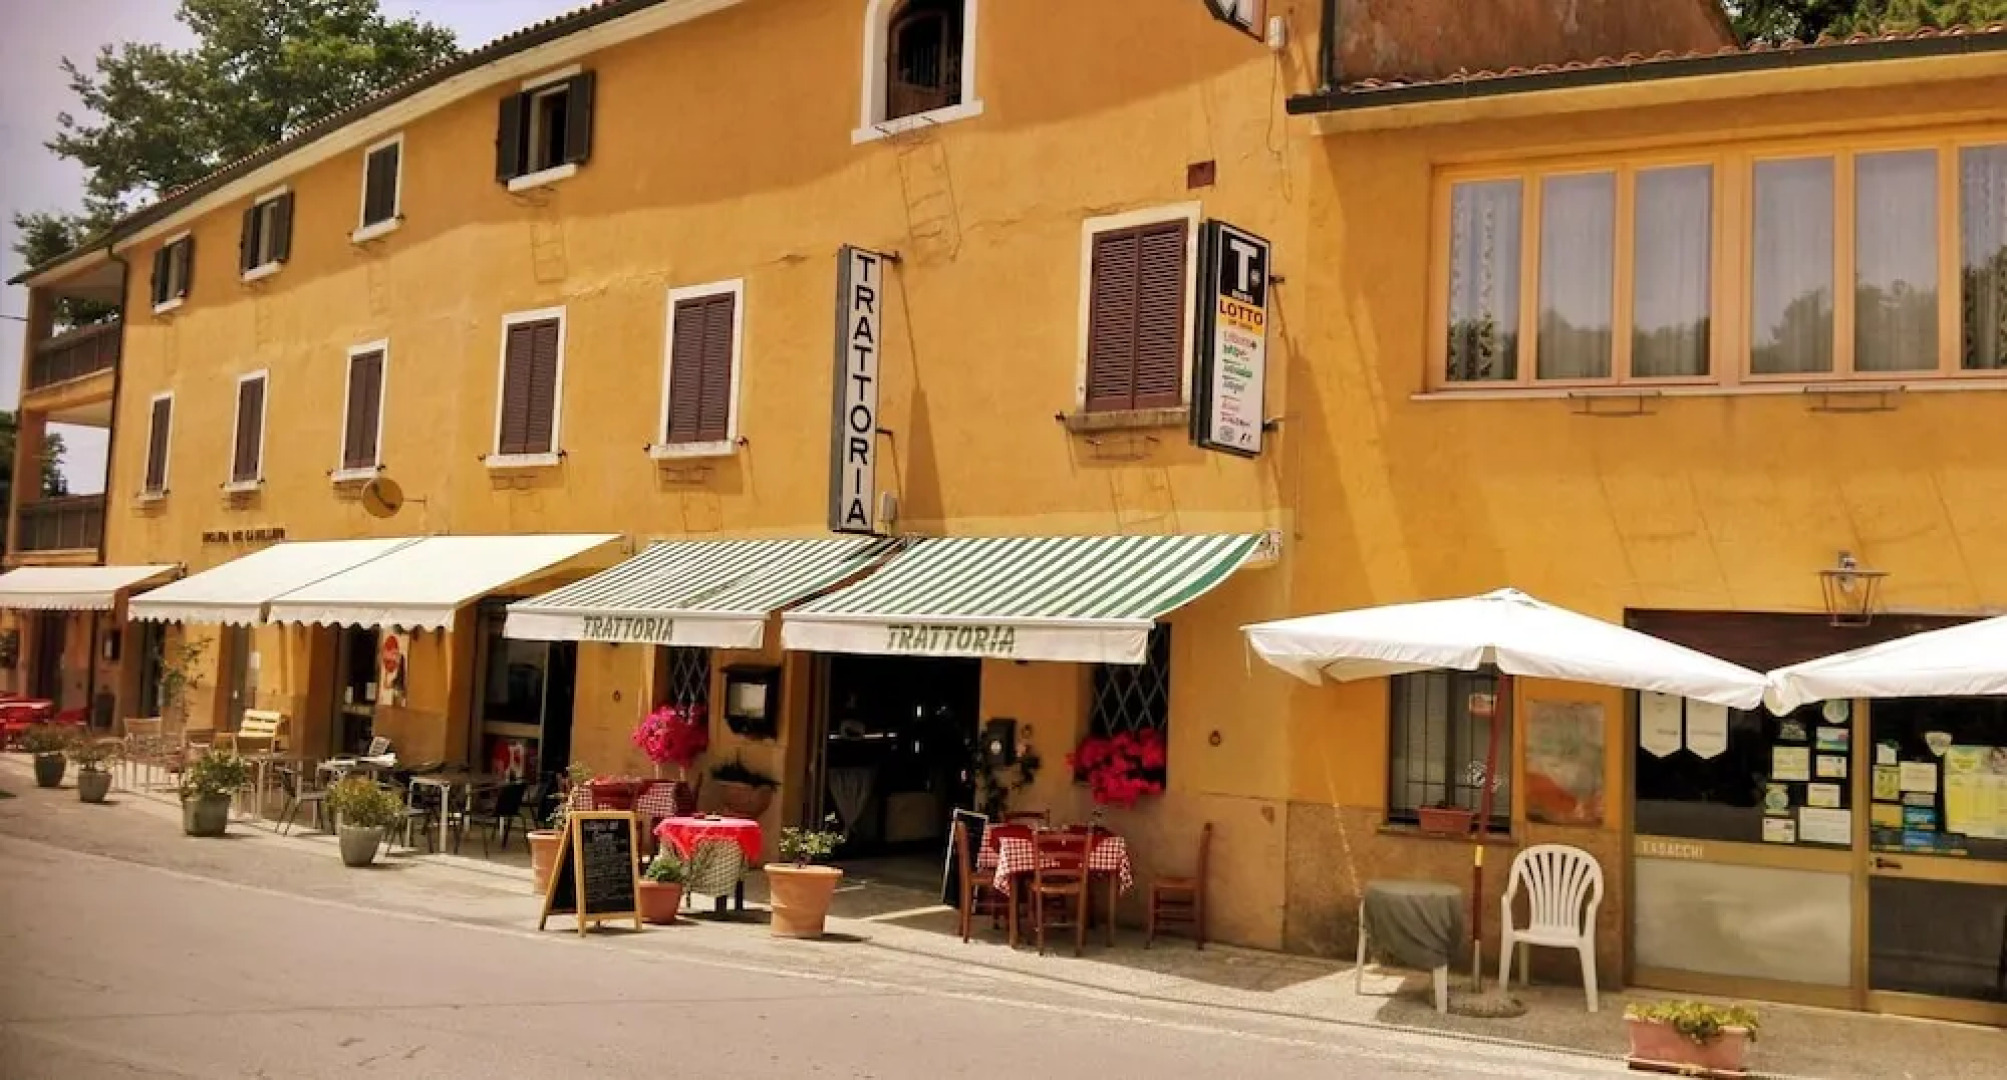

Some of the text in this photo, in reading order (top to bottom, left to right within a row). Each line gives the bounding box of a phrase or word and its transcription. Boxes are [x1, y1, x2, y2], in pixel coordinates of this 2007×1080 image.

[1230, 239, 1257, 291] T
[1219, 299, 1263, 325] LOTTO
[847, 254, 876, 525] TRATTORIA
[583, 615, 674, 641] TRATTORIA
[887, 625, 1015, 653] TRATTORIA
